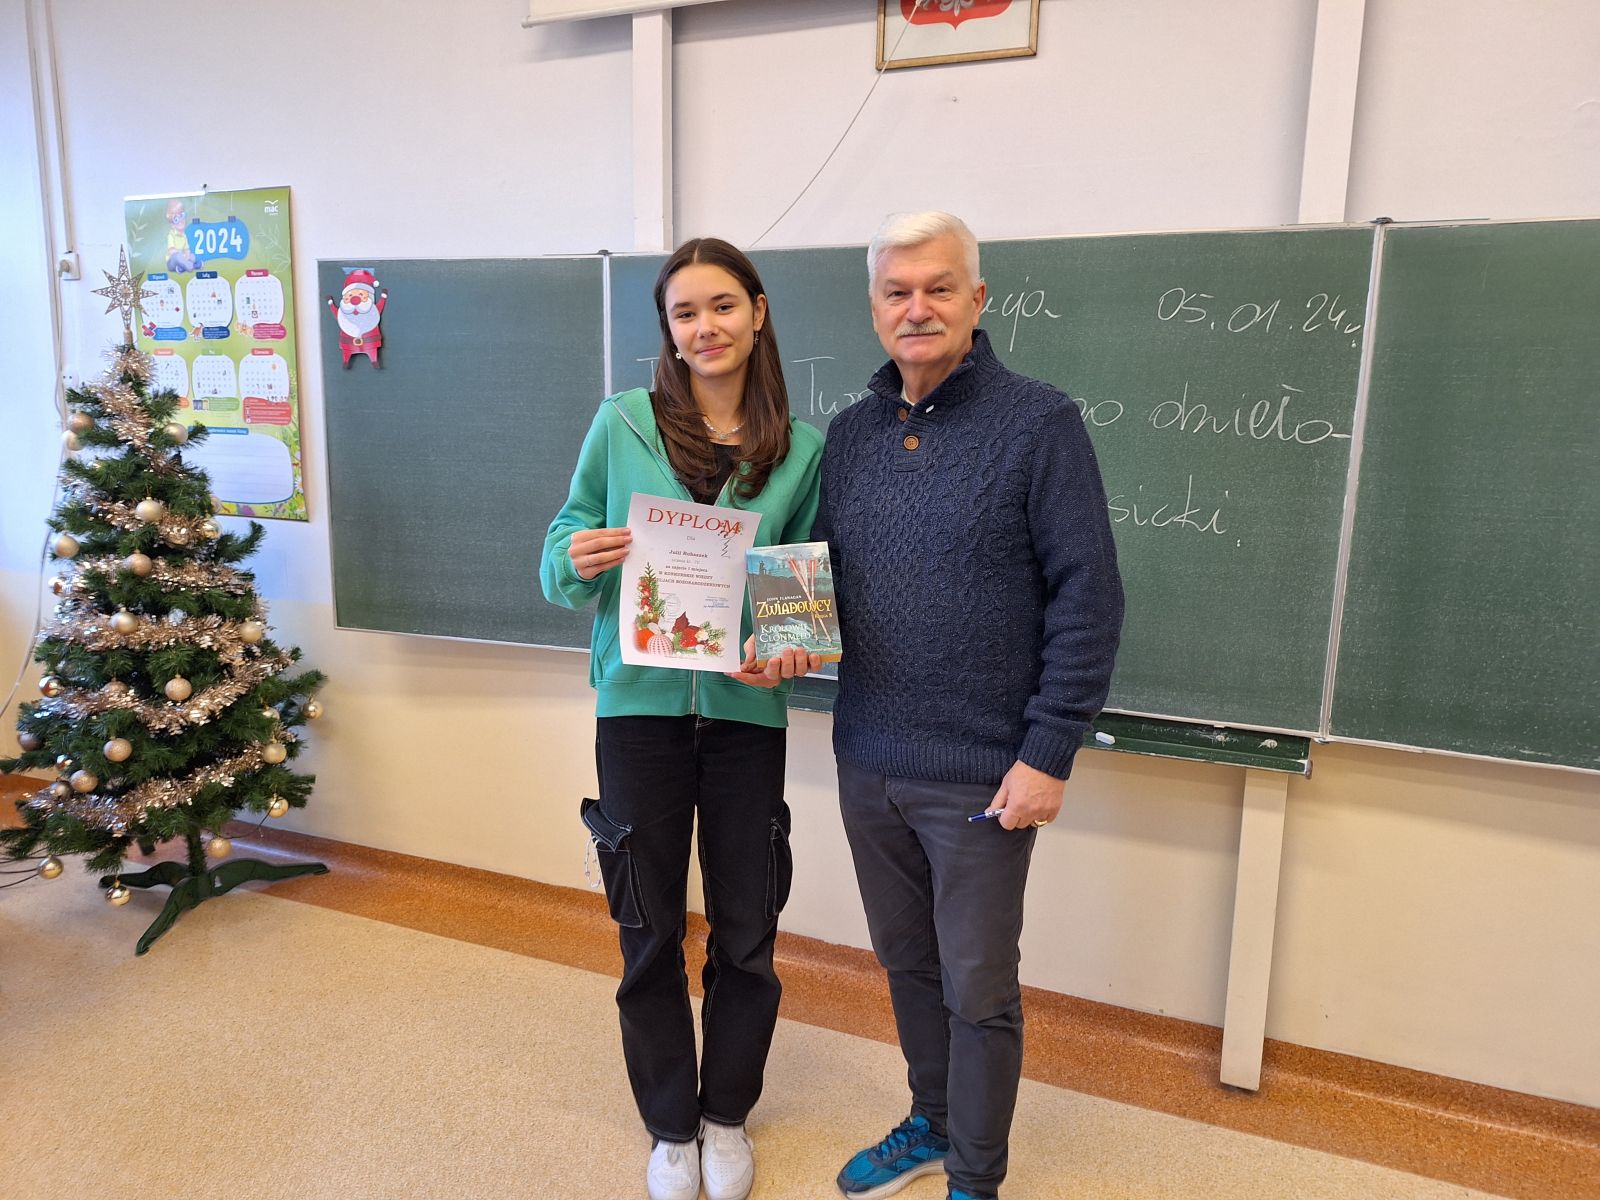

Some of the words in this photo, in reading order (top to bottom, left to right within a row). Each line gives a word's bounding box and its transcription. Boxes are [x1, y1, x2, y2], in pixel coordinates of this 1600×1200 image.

[194, 227, 243, 255] 2024
[647, 508, 741, 534] DYPLOM
[756, 599, 832, 618] ZWIADOWCY
